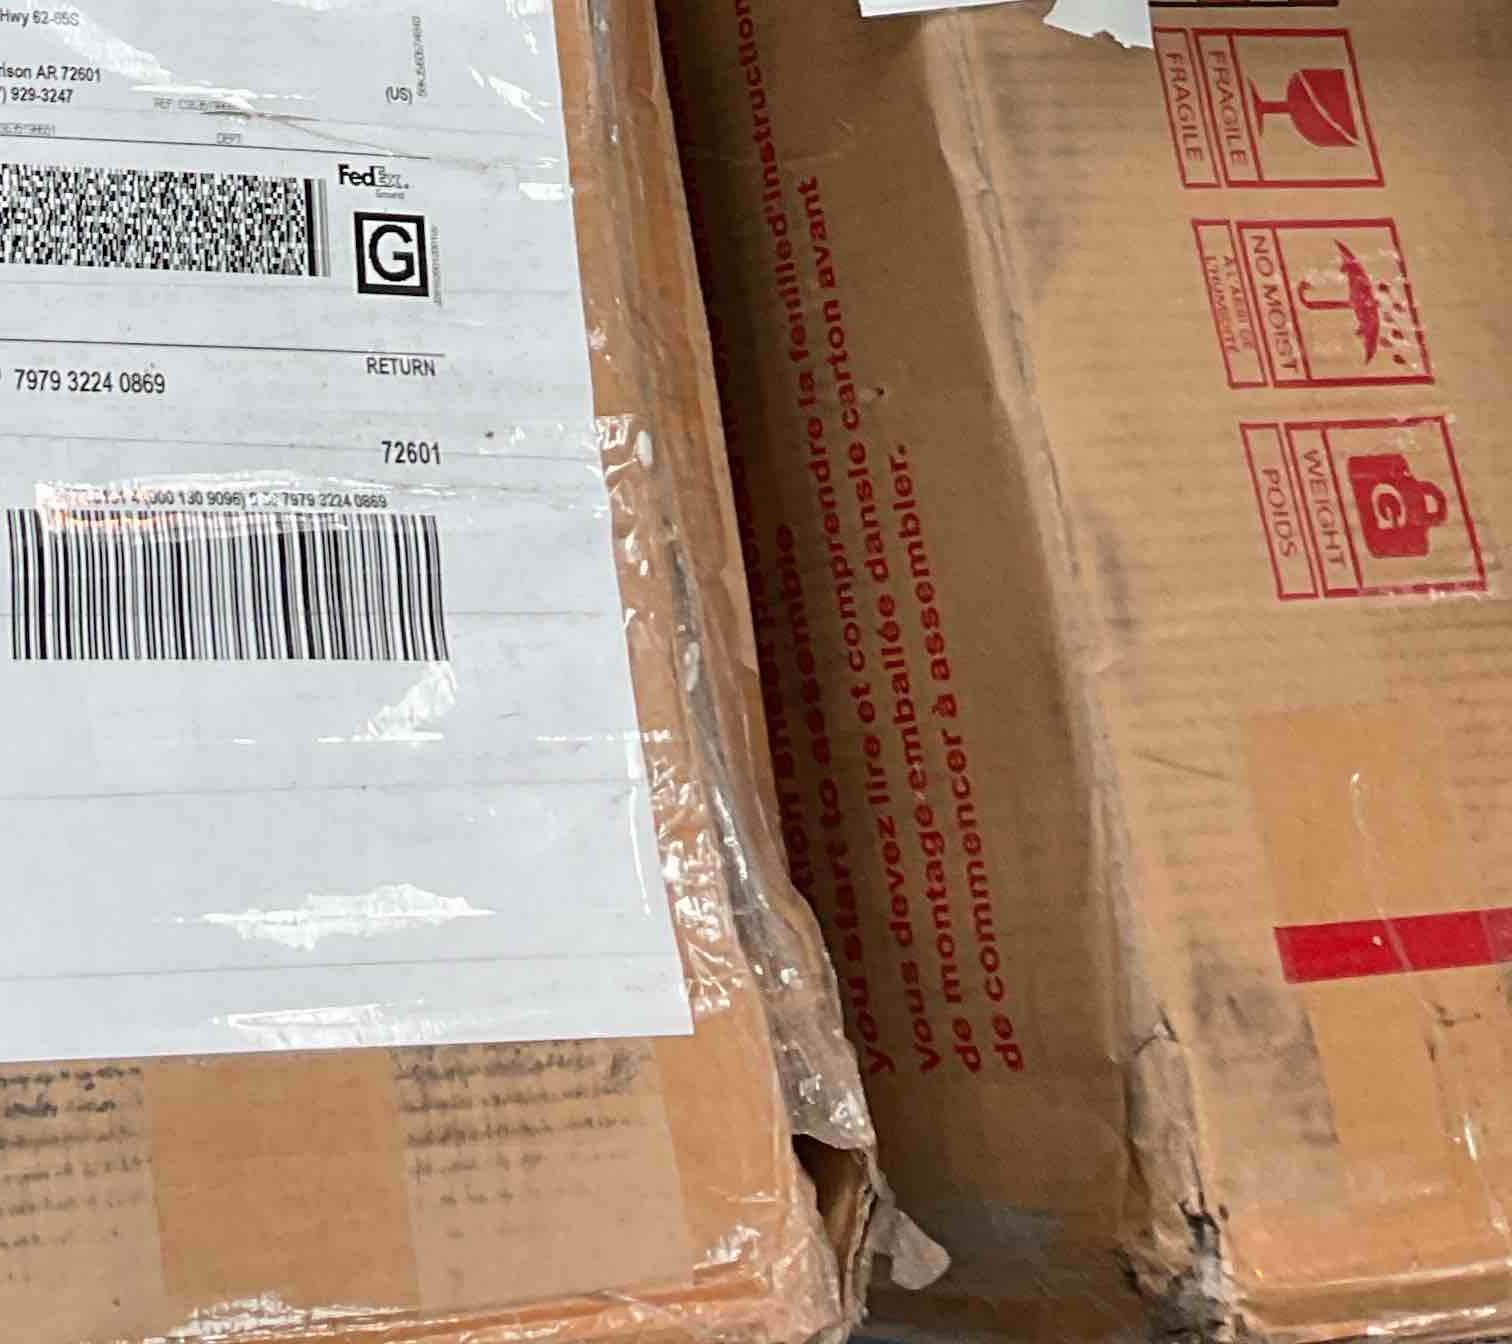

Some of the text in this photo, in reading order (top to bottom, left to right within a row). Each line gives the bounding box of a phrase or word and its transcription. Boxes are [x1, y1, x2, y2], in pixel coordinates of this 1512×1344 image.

[0, 8, 29, 27] Hwy
[10, 87, 73, 103] 929-3247
[36, 66, 59, 81] AR
[61, 67, 101, 83] 72601
[385, 85, 413, 104] (US)
[1164, 50, 1204, 163] FRAGILE
[1207, 49, 1248, 167] FRAGILE
[368, 223, 415, 282] G
[796, 174, 838, 290] avant
[1249, 233, 1275, 279] NO
[14, 368, 63, 391] 7979
[67, 370, 114, 394] 3224
[119, 371, 167, 395] 0869
[365, 356, 437, 378] RETURN
[822, 298, 862, 432] carton
[381, 440, 442, 465] 72601
[806, 415, 868, 674] comprendre
[1262, 467, 1299, 559] POIDS
[1303, 448, 1347, 570] WEIGHT
[850, 680, 877, 724] et
[873, 593, 929, 793] emballée
[817, 777, 848, 829] to
[864, 734, 890, 808] lire
[888, 441, 1024, 1073] de commencer à assembler.
[824, 842, 862, 960] start
[876, 815, 914, 948] devez
[912, 801, 964, 1005] montage
[844, 979, 896, 1075] you
[898, 960, 941, 1073] vous
[952, 1016, 983, 1075] de
